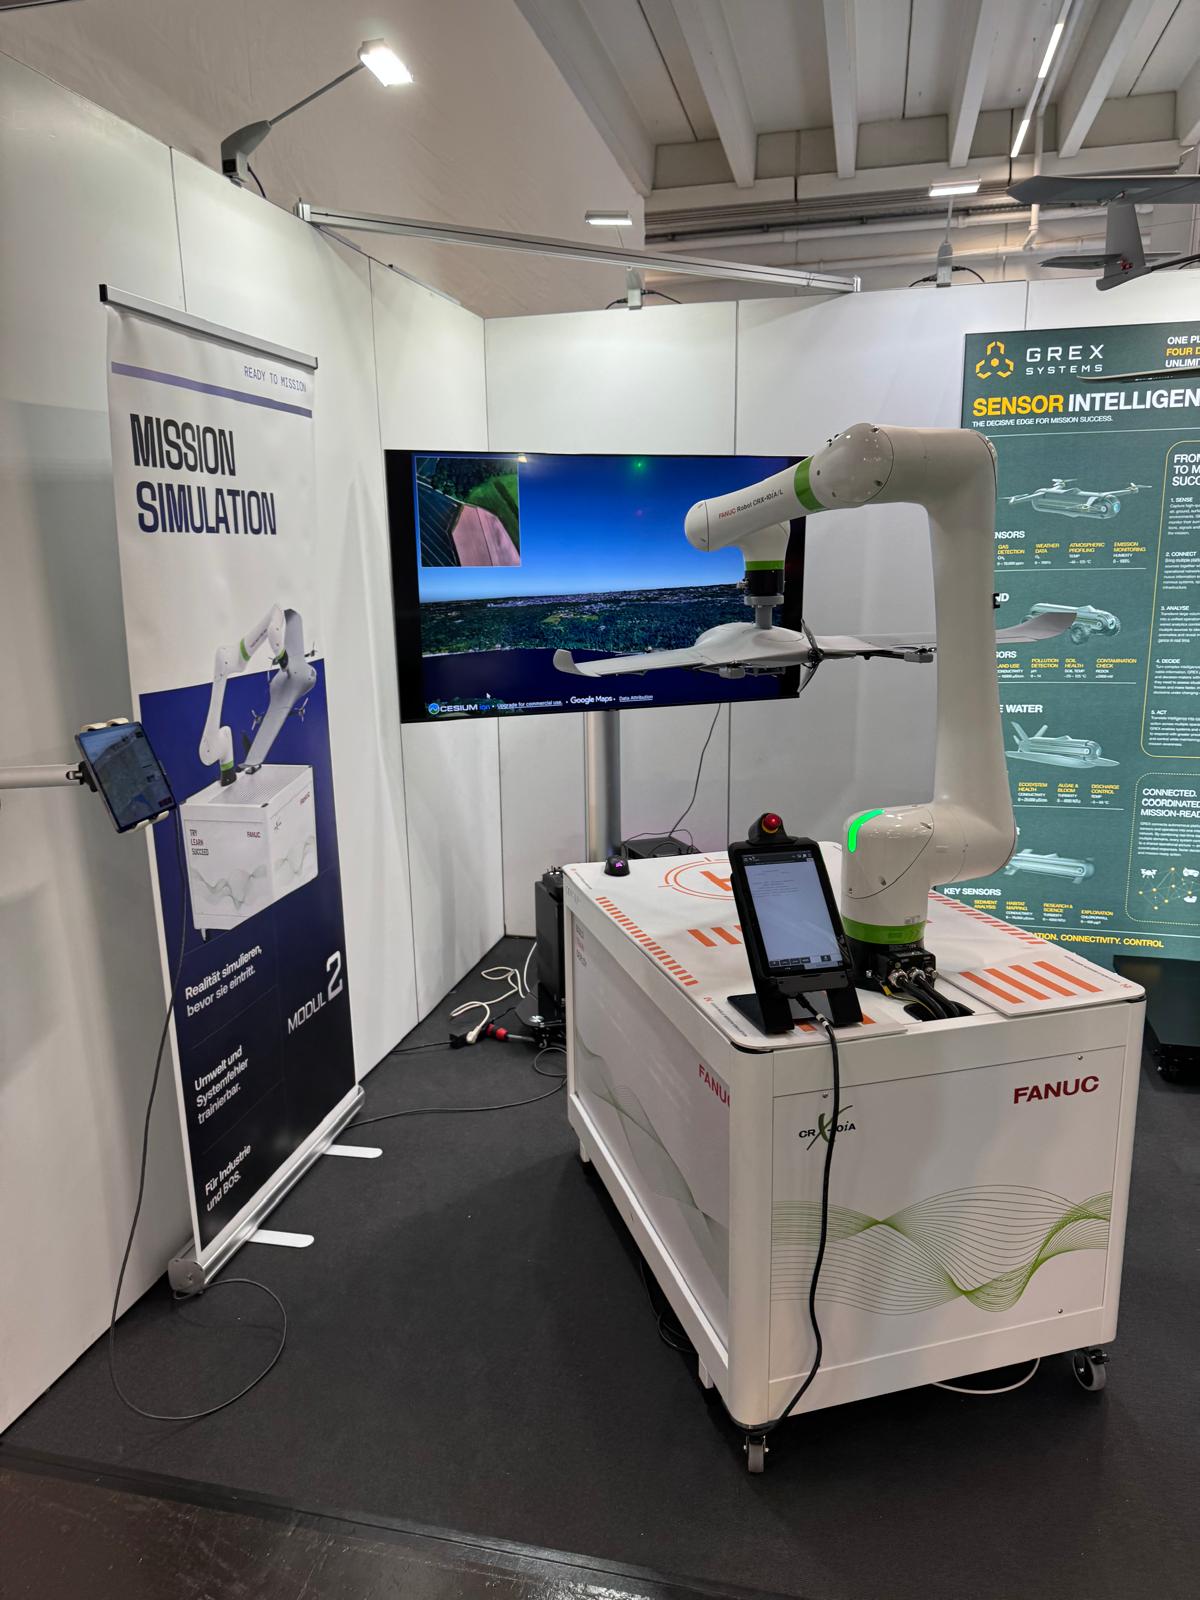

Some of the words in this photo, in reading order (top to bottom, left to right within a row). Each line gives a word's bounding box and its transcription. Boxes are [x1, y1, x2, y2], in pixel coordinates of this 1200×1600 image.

[1167, 336, 1188, 345] ONE
[1026, 344, 1104, 363] GREX
[1166, 347, 1193, 357] FOUR
[243, 365, 266, 381] READY
[270, 372, 278, 385] TO
[280, 375, 307, 393] MISSION
[1025, 364, 1103, 376] SYSTEMS
[972, 394, 1064, 417] SENSOR
[972, 420, 986, 428] THE
[986, 418, 1015, 427] DECISIVE
[1016, 417, 1035, 426] EDGE
[1036, 417, 1050, 425] FOR
[1051, 416, 1079, 424] MISSION
[1080, 414, 1114, 423] SUCCESS.
[130, 413, 236, 477] MISSION
[1173, 465, 1189, 475] TO
[136, 480, 277, 536] SIMULATION
[718, 507, 737, 520] FANUC
[736, 502, 752, 513] Robot
[440, 703, 479, 713] CESIUM
[570, 695, 595, 705] Google
[595, 695, 613, 704] Maps
[1005, 704, 1043, 713] WATER
[1142, 788, 1198, 797] CONNECTED.
[944, 887, 961, 895] KEY
[962, 888, 1002, 896] SENSORS
[1060, 934, 1122, 945] CONNECTIVITY.
[185, 970, 221, 1000] Realität
[221, 945, 263, 979] simulieren,
[186, 992, 214, 1017] bevor
[216, 984, 228, 999] sie
[229, 965, 256, 990] eintritt.
[287, 991, 327, 1034] MODUL
[326, 950, 344, 1002] 2
[194, 1058, 227, 1091] Umwelt
[227, 1045, 243, 1066] und
[196, 1058, 249, 1108] Systemfehler
[699, 1063, 730, 1107] FANU
[1013, 1075, 1100, 1104] FANUC
[197, 1082, 242, 1125] trainierbar.
[205, 1176, 219, 1196] Für
[219, 1144, 252, 1179] Industrie
[206, 1190, 222, 1212] und
